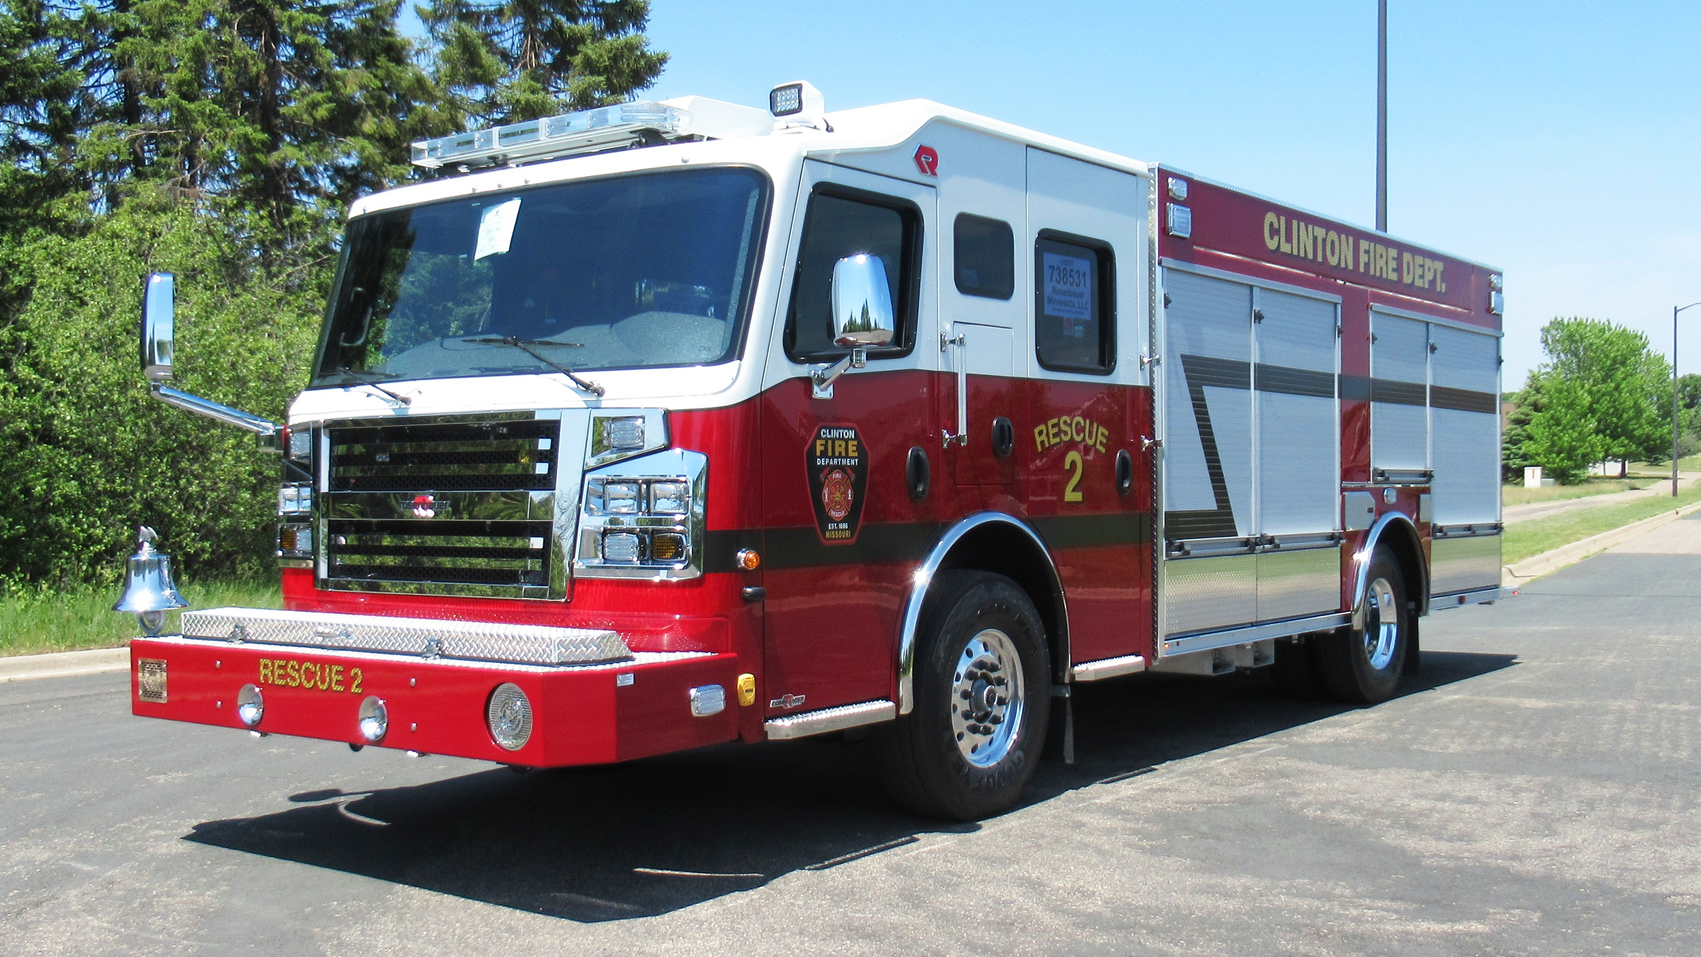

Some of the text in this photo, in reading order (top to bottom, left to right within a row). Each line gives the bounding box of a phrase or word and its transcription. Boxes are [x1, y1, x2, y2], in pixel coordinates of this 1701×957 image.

[1263, 211, 1446, 293] CLINTON FIRE DEPT.
[1049, 264, 1087, 288] 738531
[1077, 300, 1089, 310] LLC
[820, 428, 855, 439] CLINTON
[1033, 415, 1109, 454] RESCUE
[815, 439, 859, 457] FIRE
[816, 457, 859, 466] DEPARTMENT
[1064, 450, 1083, 501] 2
[825, 530, 851, 539] MISSOURI
[259, 658, 363, 693] RESCUE 2
